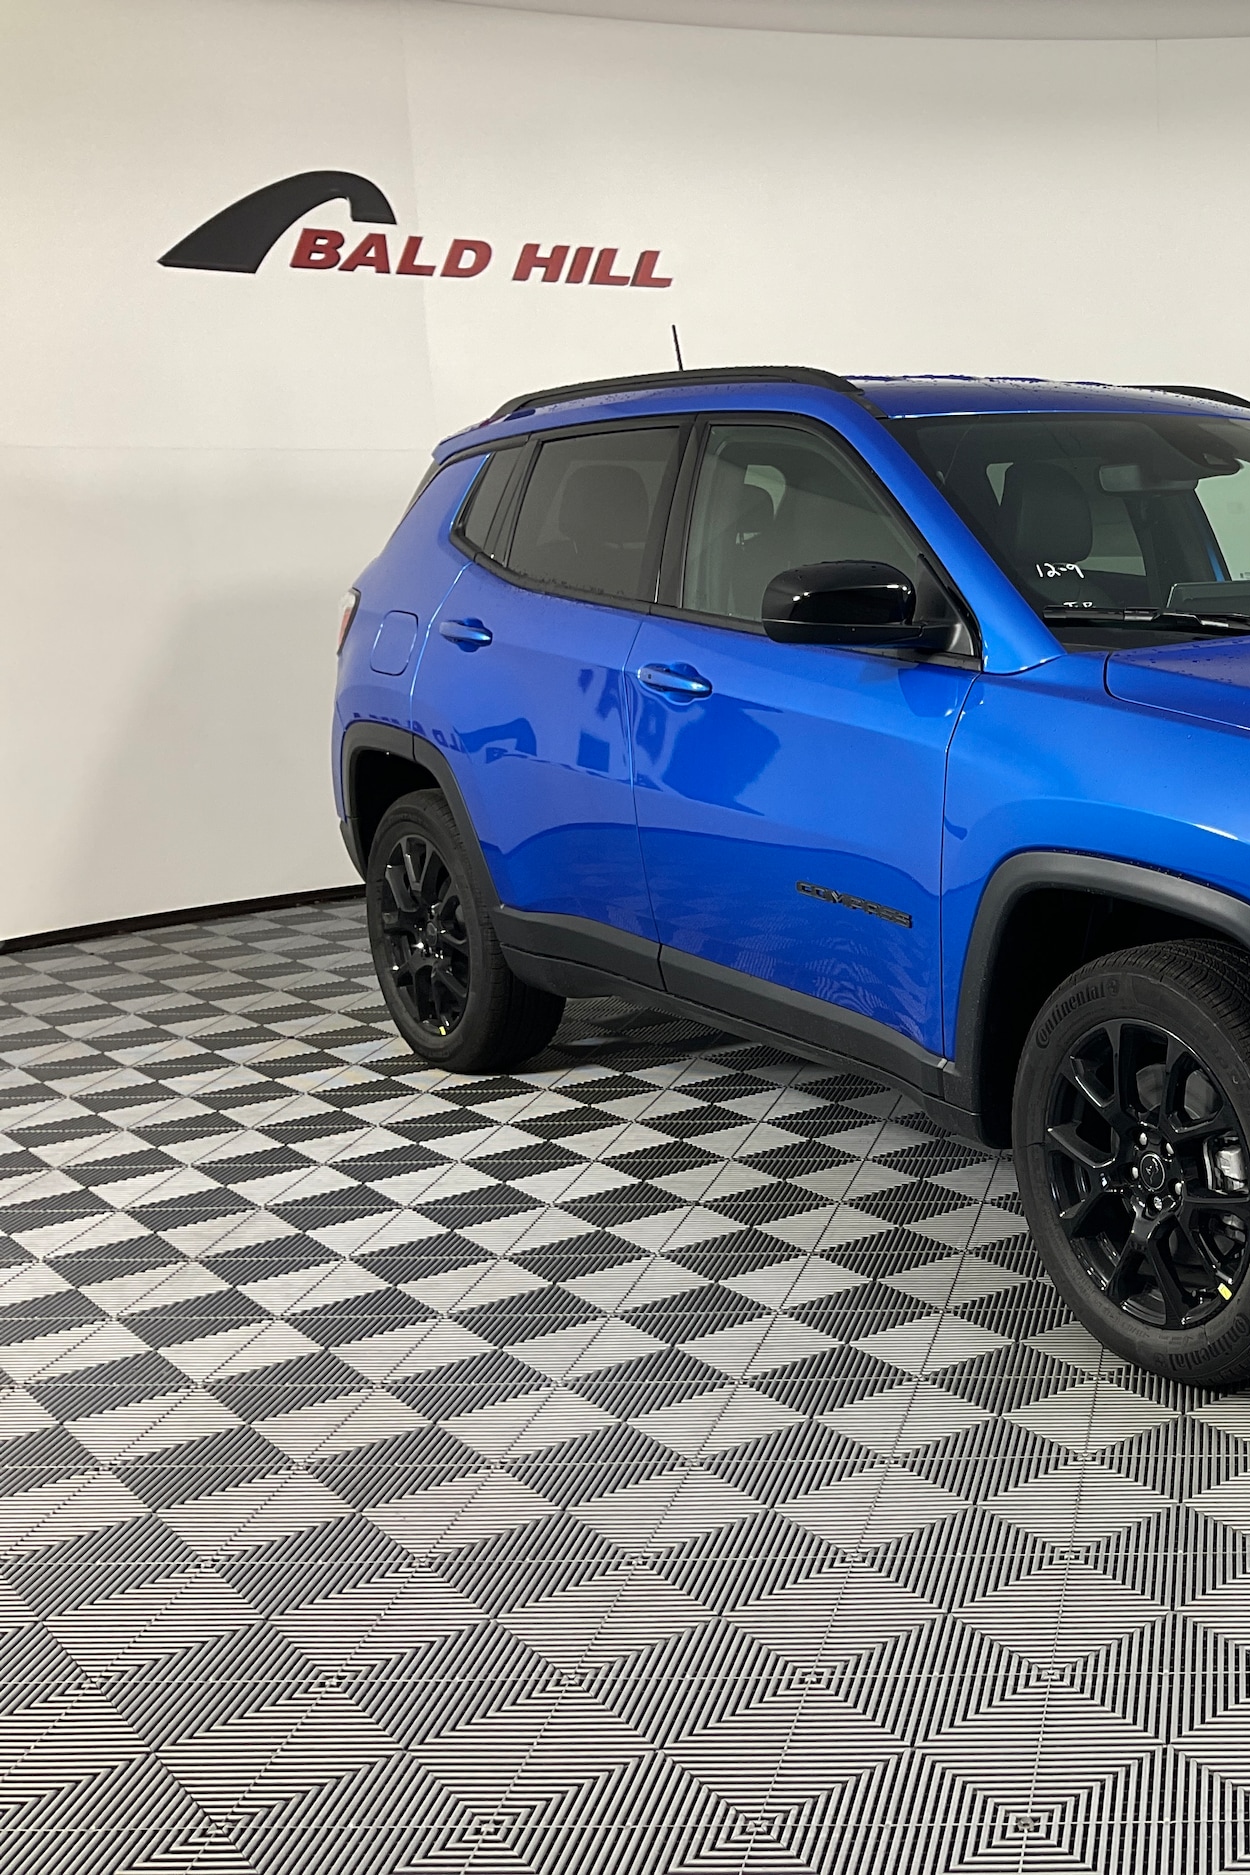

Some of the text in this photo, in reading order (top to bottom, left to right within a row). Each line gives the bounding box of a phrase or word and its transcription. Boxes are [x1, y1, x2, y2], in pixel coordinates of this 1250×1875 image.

[290, 228, 673, 288] BALD HILL
[1036, 562, 1085, 578] 12-9
[796, 880, 912, 928] COMPASS
[1035, 981, 1106, 1049] Continental
